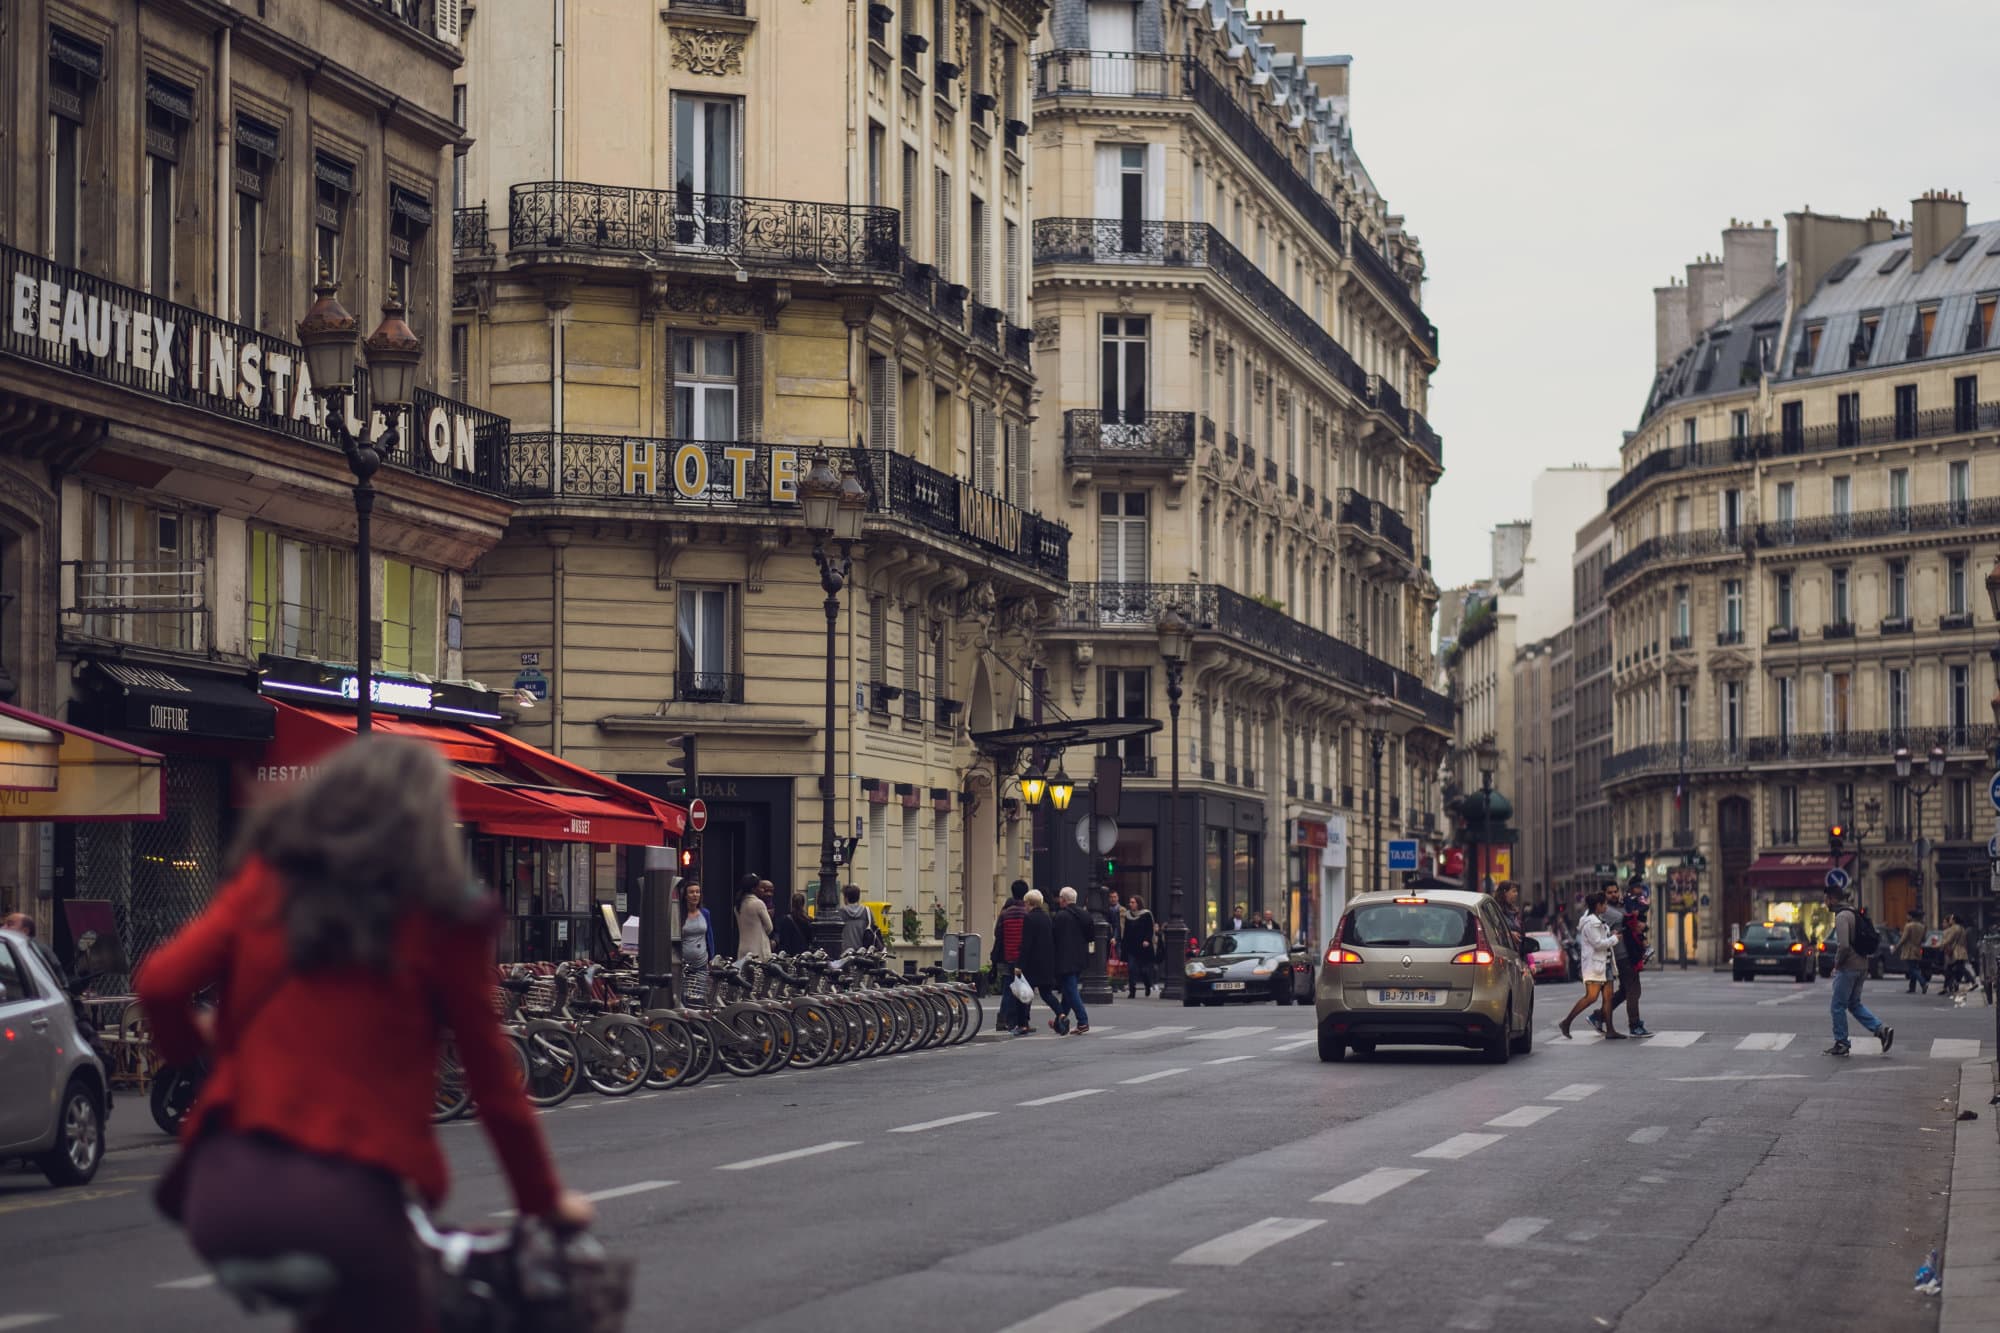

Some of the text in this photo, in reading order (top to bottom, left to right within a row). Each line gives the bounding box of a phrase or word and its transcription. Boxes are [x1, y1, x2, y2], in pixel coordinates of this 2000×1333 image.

[13, 272, 176, 379] BEAUTEX
[623, 442, 798, 503] HOTE
[959, 482, 1023, 556] NORMANDY
[150, 704, 190, 731] COIFFURE
[702, 782, 738, 798] BAR
[1391, 849, 1415, 860] TAXIS
